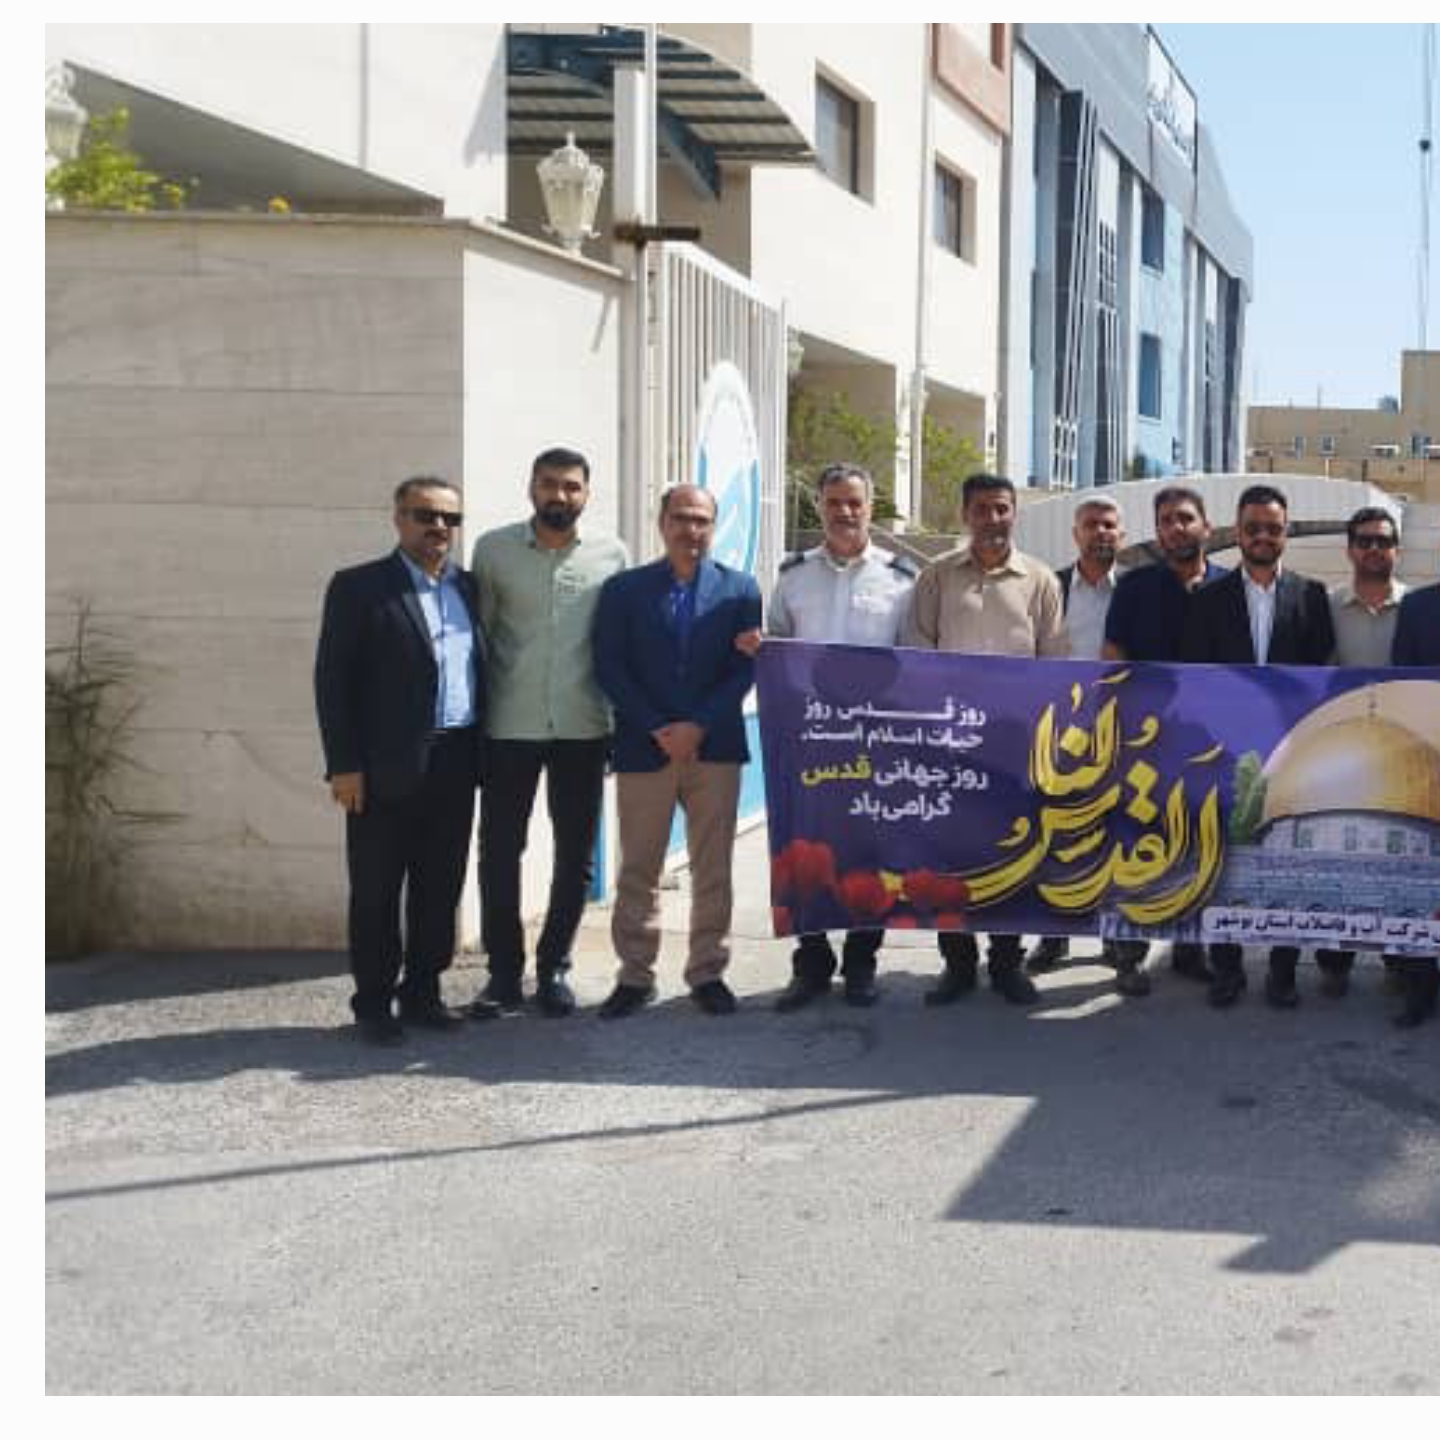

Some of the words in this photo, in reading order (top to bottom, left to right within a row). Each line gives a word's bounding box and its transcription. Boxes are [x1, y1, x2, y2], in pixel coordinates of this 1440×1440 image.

[804, 696, 831, 720] روز
[957, 704, 986, 726] روز
[867, 725, 922, 748] اسلام
[926, 726, 984, 753] حیات
[801, 754, 872, 785] قدس
[874, 759, 950, 789] جهانی
[951, 764, 988, 790] روز
[848, 791, 881, 822] باد
[881, 790, 953, 821] گرامی
[1214, 916, 1253, 931] بوشهر
[1256, 914, 1293, 930] استان
[1297, 913, 1346, 932] فاضلاب
[1387, 922, 1430, 942] شرکت
